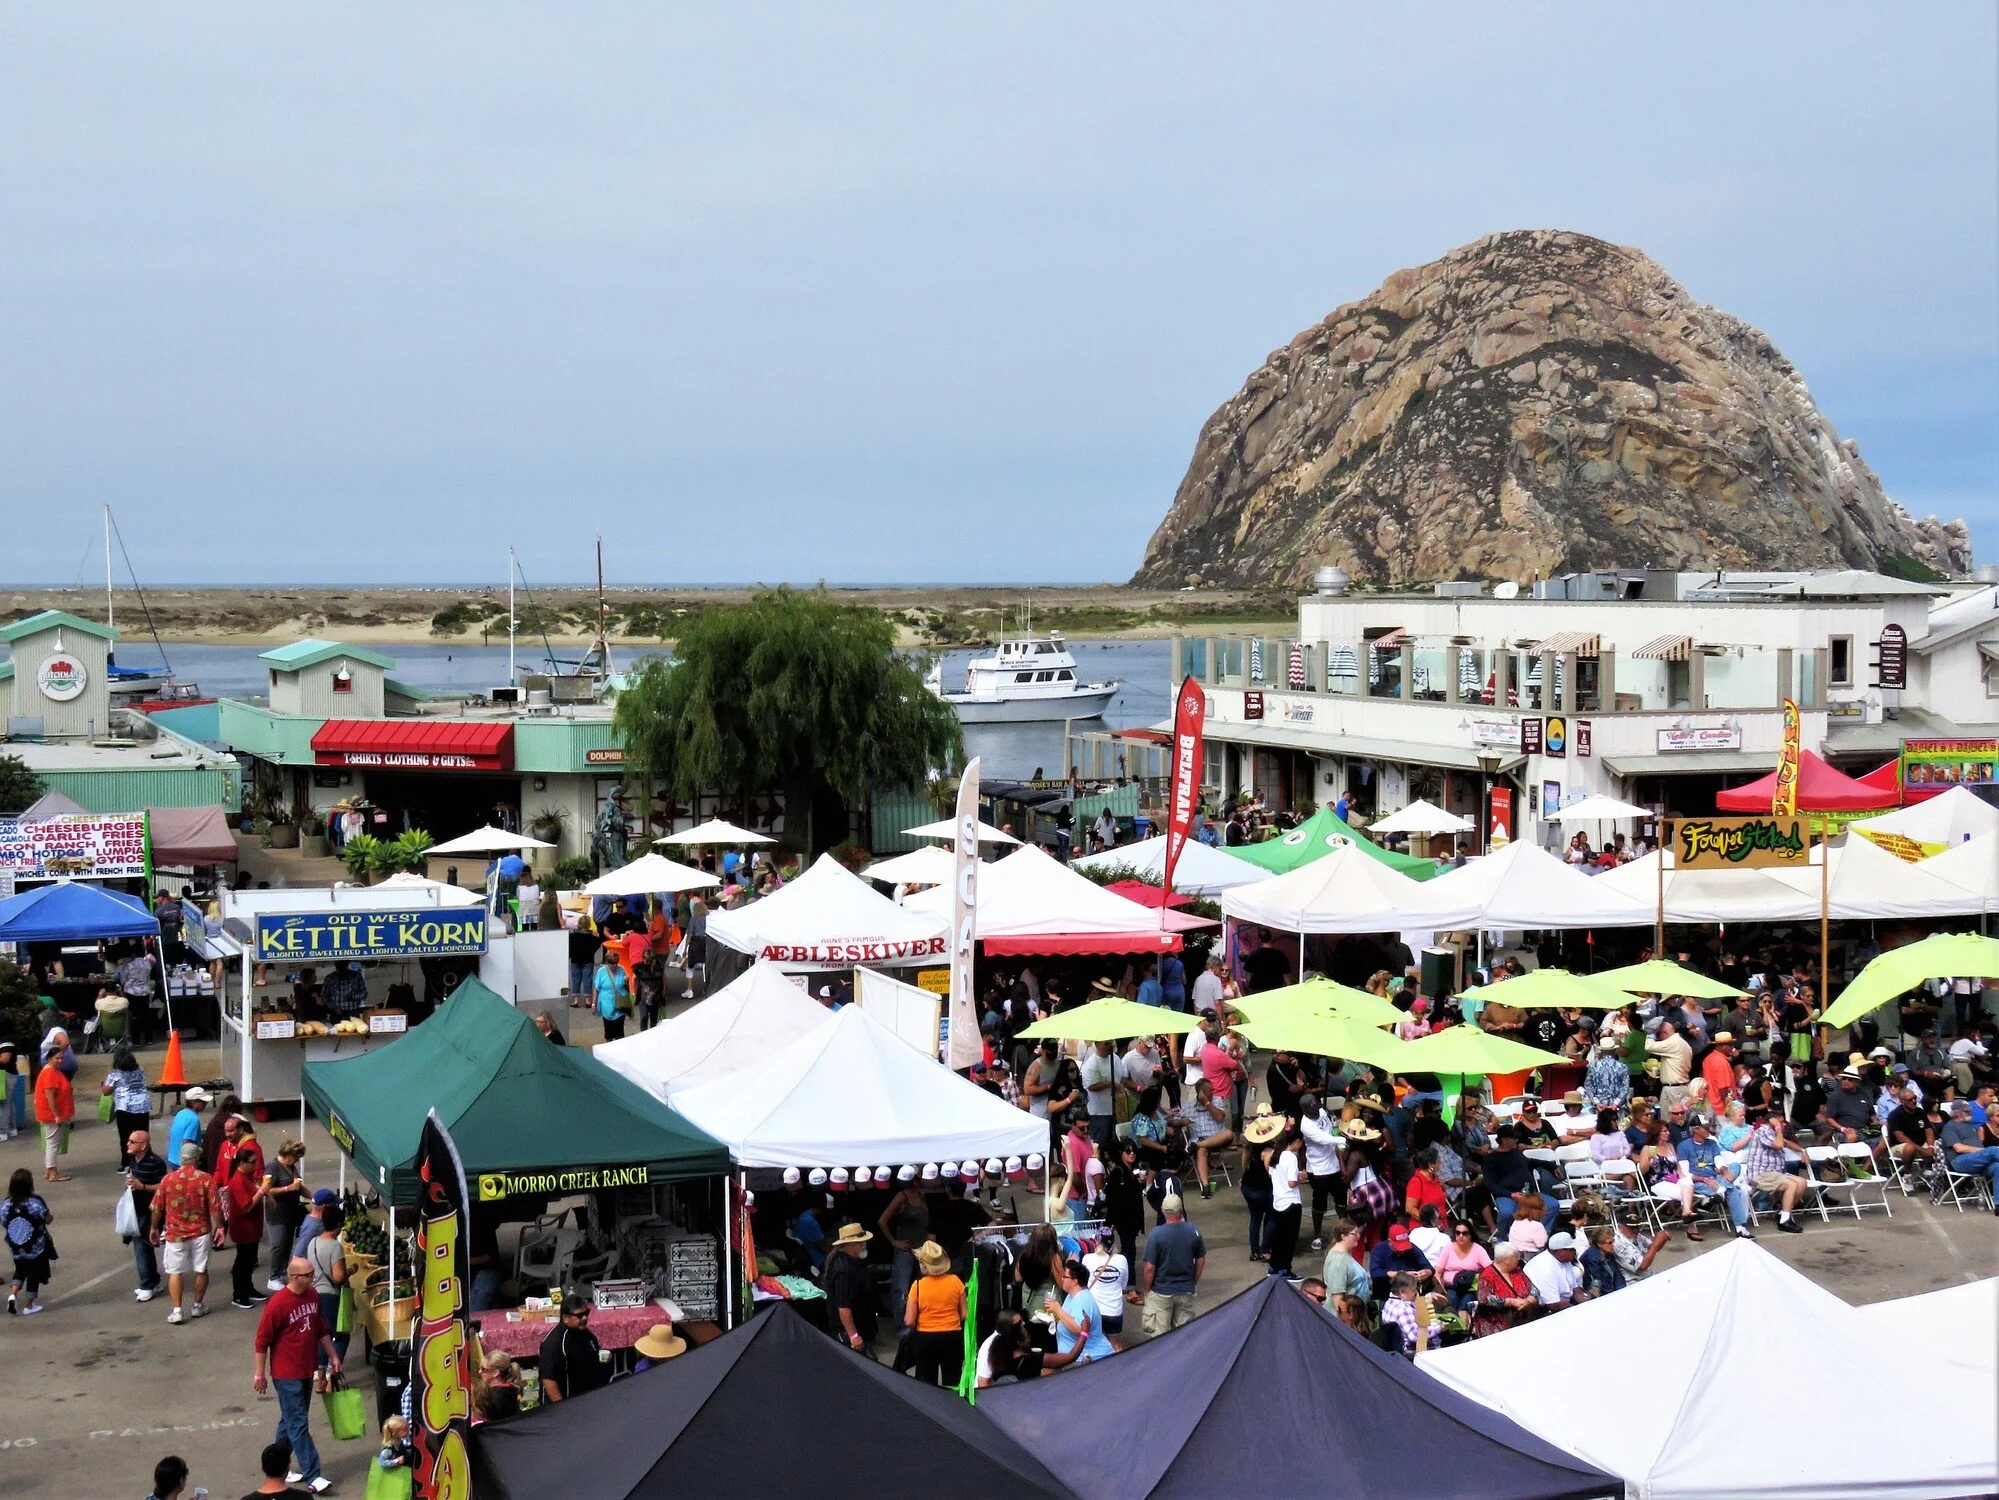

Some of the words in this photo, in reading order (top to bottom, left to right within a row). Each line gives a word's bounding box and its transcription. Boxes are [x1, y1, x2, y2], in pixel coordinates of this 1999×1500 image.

[1700, 731, 1732, 740] Candies
[344, 753, 382, 764] T-SHIRTS
[385, 754, 429, 766] CLOTHING
[441, 756, 466, 767] GIFTS
[590, 752, 622, 760] DOLPHIN
[1176, 734, 1196, 824] BELTRAN
[24, 822, 144, 834] CHEESEBURGER
[32, 832, 92, 842] GARLIC
[102, 830, 144, 840] FRIES
[45, 840, 96, 850] RANCH
[105, 839, 142, 848] FRIES
[32, 848, 85, 858] HOTDOG
[96, 846, 144, 856] LUMPIA
[97, 855, 144, 864] GYROS
[96, 867, 122, 875] FRENCH
[328, 914, 362, 925] OLD
[369, 914, 420, 923] WEST
[262, 926, 385, 950] KETTLE
[400, 921, 484, 947] KORN
[309, 949, 360, 958] SWEETENED
[507, 1175, 556, 1194] MORRO
[560, 1172, 600, 1190] CREEK
[602, 1167, 648, 1188] RANCH
[290, 1302, 318, 1324] ALABAM
